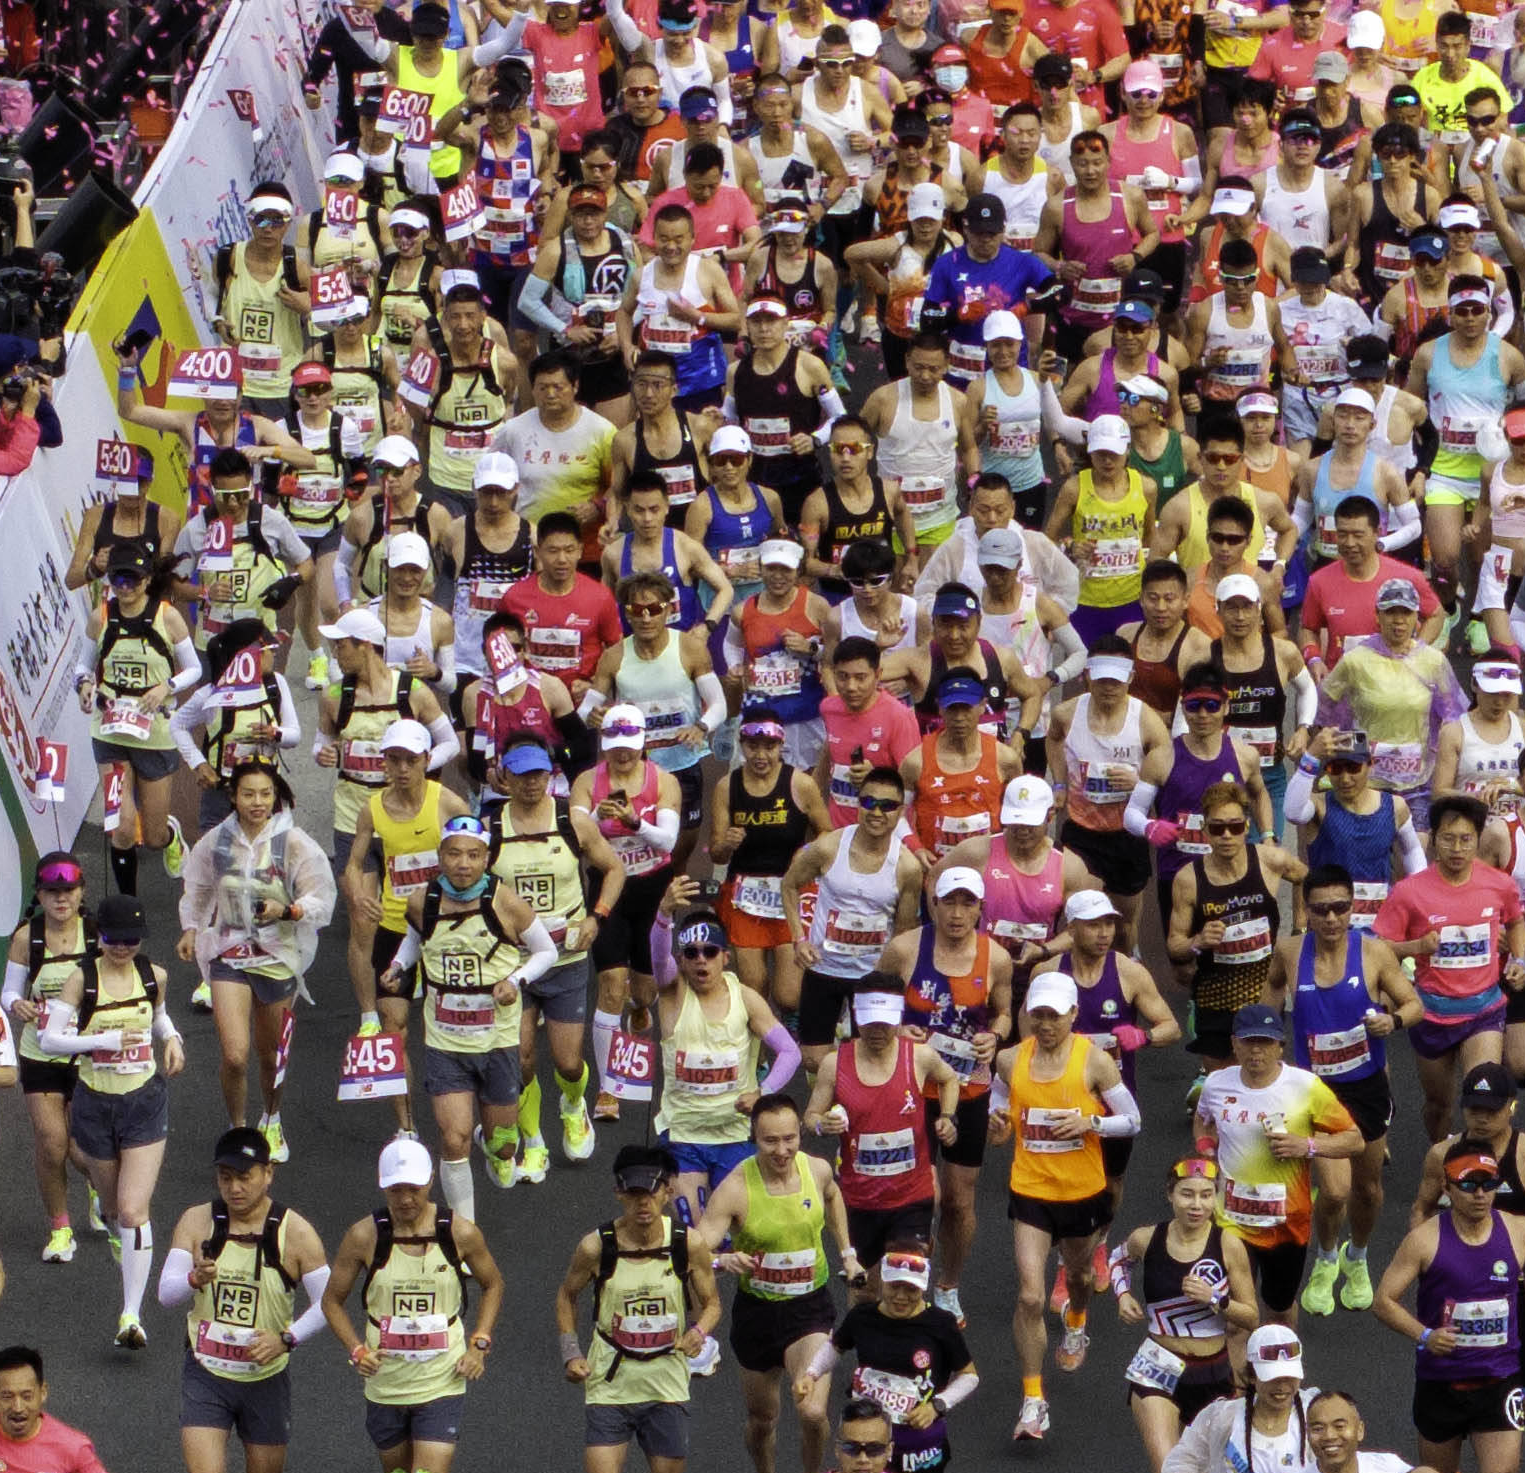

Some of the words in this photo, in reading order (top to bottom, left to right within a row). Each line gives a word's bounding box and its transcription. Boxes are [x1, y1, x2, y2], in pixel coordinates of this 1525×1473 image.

[245, 312, 271, 327] NB
[245, 328, 270, 341] RC
[180, 354, 233, 380] 4:00
[100, 447, 132, 477] 5:30
[521, 879, 550, 895] NB
[447, 956, 478, 972] NB
[859, 1146, 911, 1166] 51227
[222, 1287, 254, 1304] NB
[399, 1296, 429, 1312] NB
[630, 1298, 660, 1317] NB
[222, 1306, 254, 1322] RC
